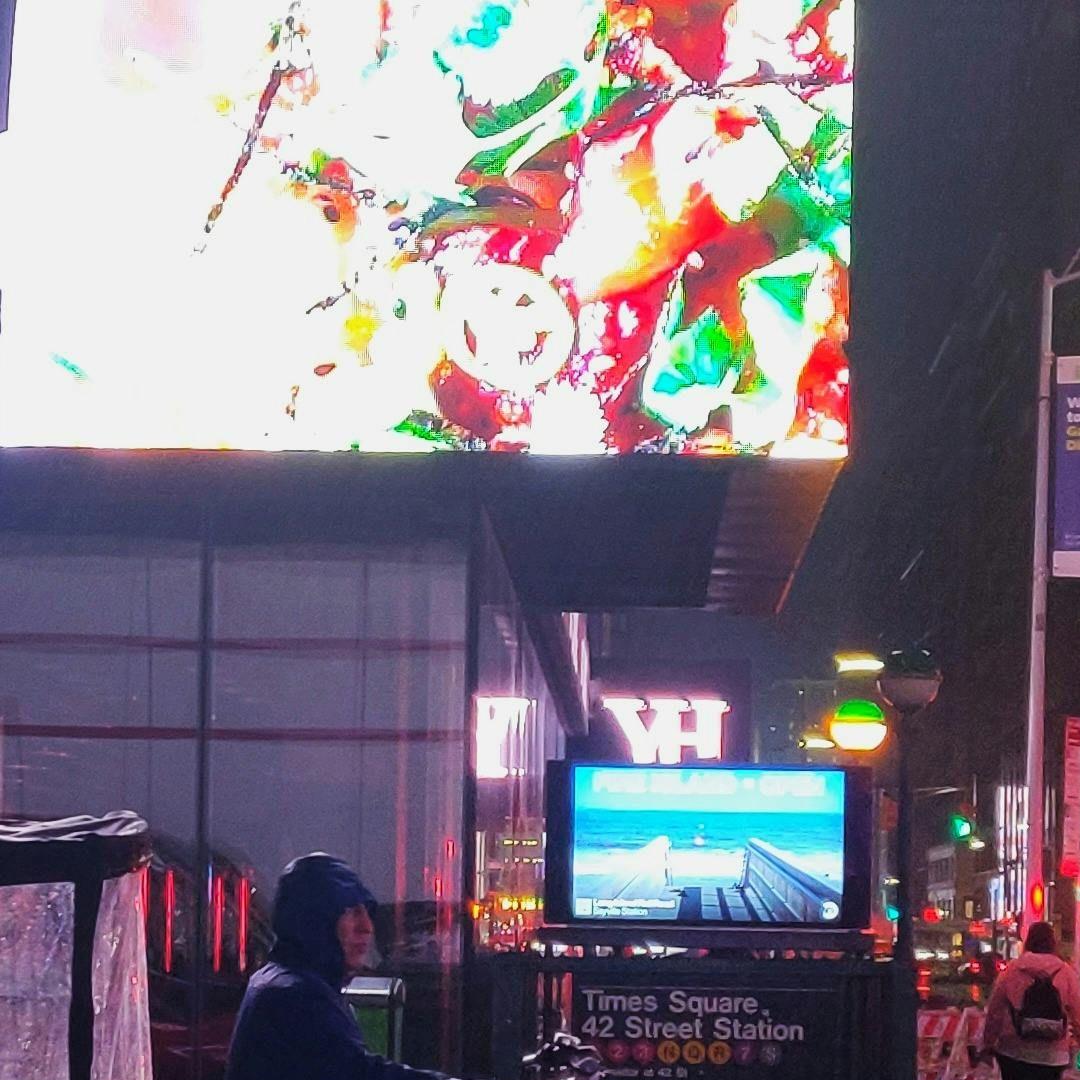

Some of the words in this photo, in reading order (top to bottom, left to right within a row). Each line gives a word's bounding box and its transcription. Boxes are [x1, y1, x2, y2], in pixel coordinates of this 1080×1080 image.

[581, 989, 658, 1012] Times
[581, 1015, 615, 1038] 42
[624, 1015, 703, 1040] Street
[713, 1016, 804, 1041] Station
